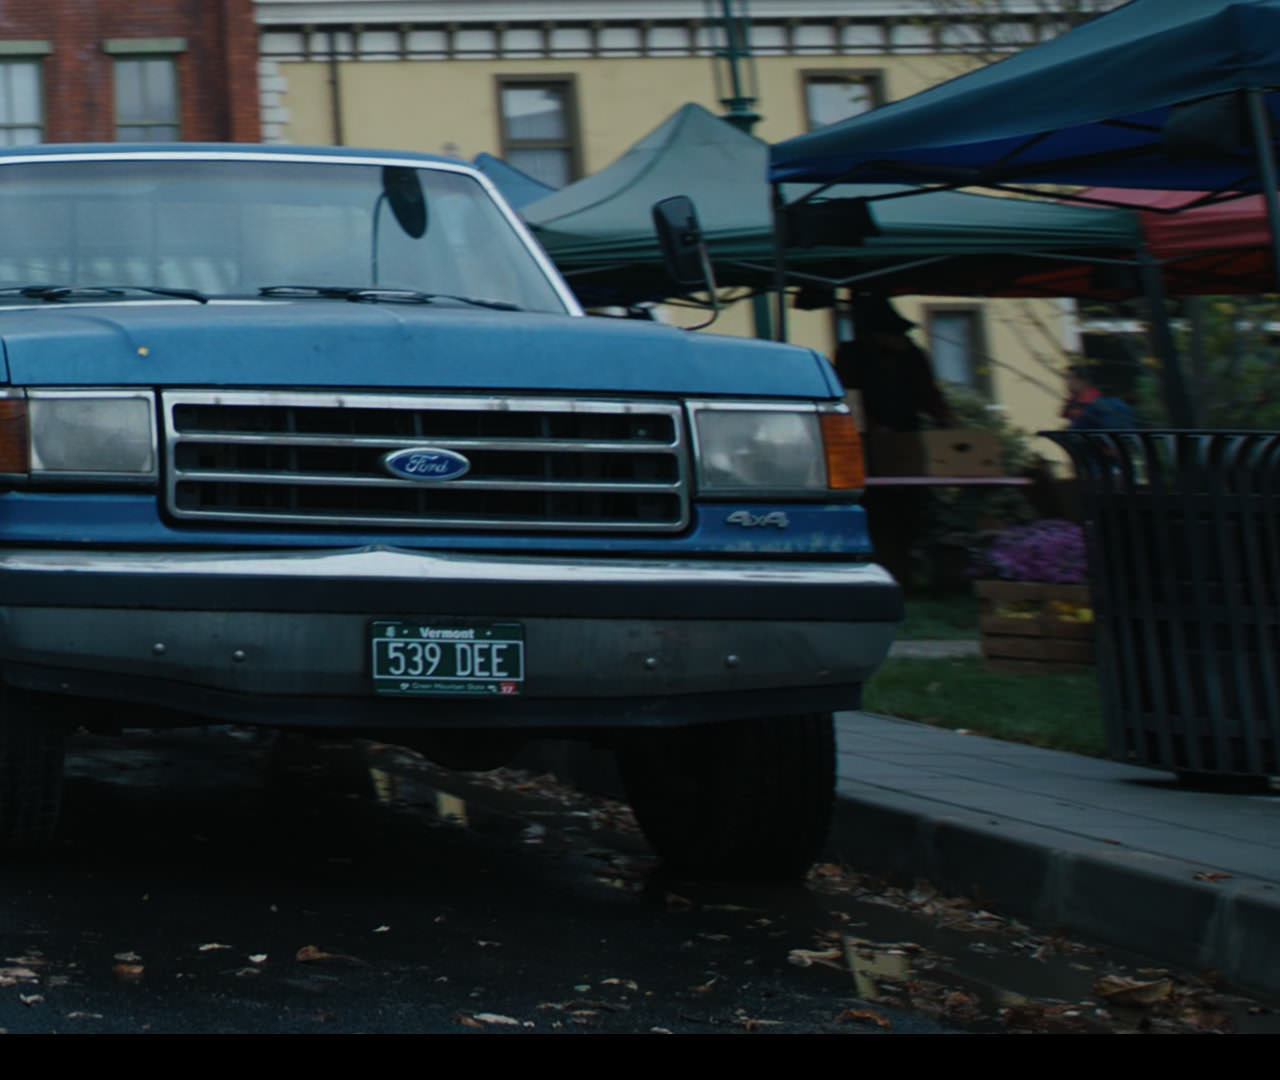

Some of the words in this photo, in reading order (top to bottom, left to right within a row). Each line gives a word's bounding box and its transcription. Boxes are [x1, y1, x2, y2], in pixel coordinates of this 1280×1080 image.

[405, 454, 449, 473] Ford
[727, 510, 790, 527] 4x4
[419, 626, 475, 639] Vermont
[388, 642, 441, 676] 539
[455, 643, 509, 677] DEE
